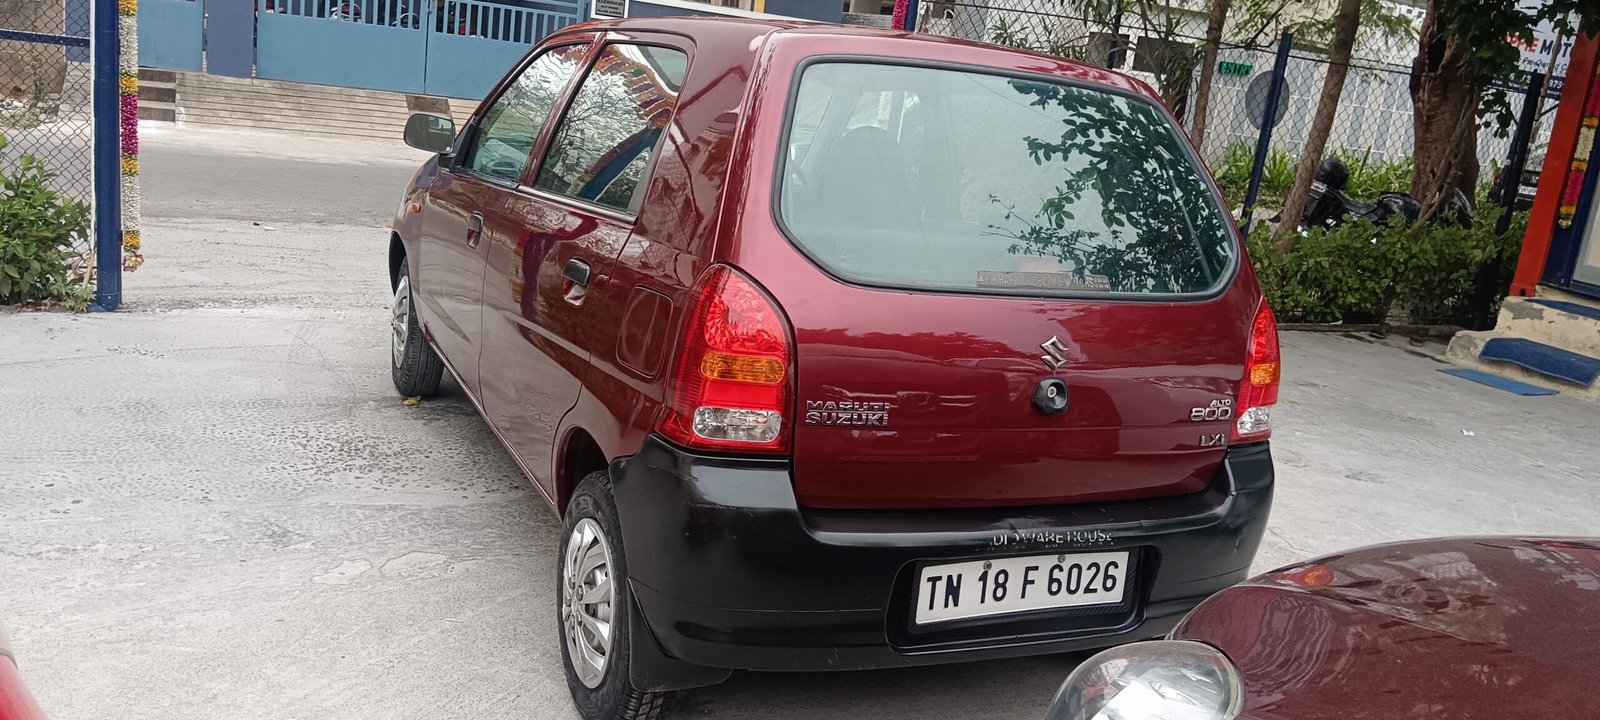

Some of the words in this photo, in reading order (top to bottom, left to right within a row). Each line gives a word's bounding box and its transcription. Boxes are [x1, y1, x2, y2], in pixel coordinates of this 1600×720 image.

[1219, 61, 1253, 76] ENTRY
[806, 400, 890, 412] MARUTI
[1210, 399, 1231, 408] ALTO
[805, 411, 889, 426] SUZUKI
[1190, 406, 1231, 421] 800
[1200, 433, 1225, 447] LXi
[927, 573, 962, 610] TN
[978, 569, 1009, 605] 18
[1020, 565, 1040, 599] F
[1047, 560, 1119, 597] 6026
